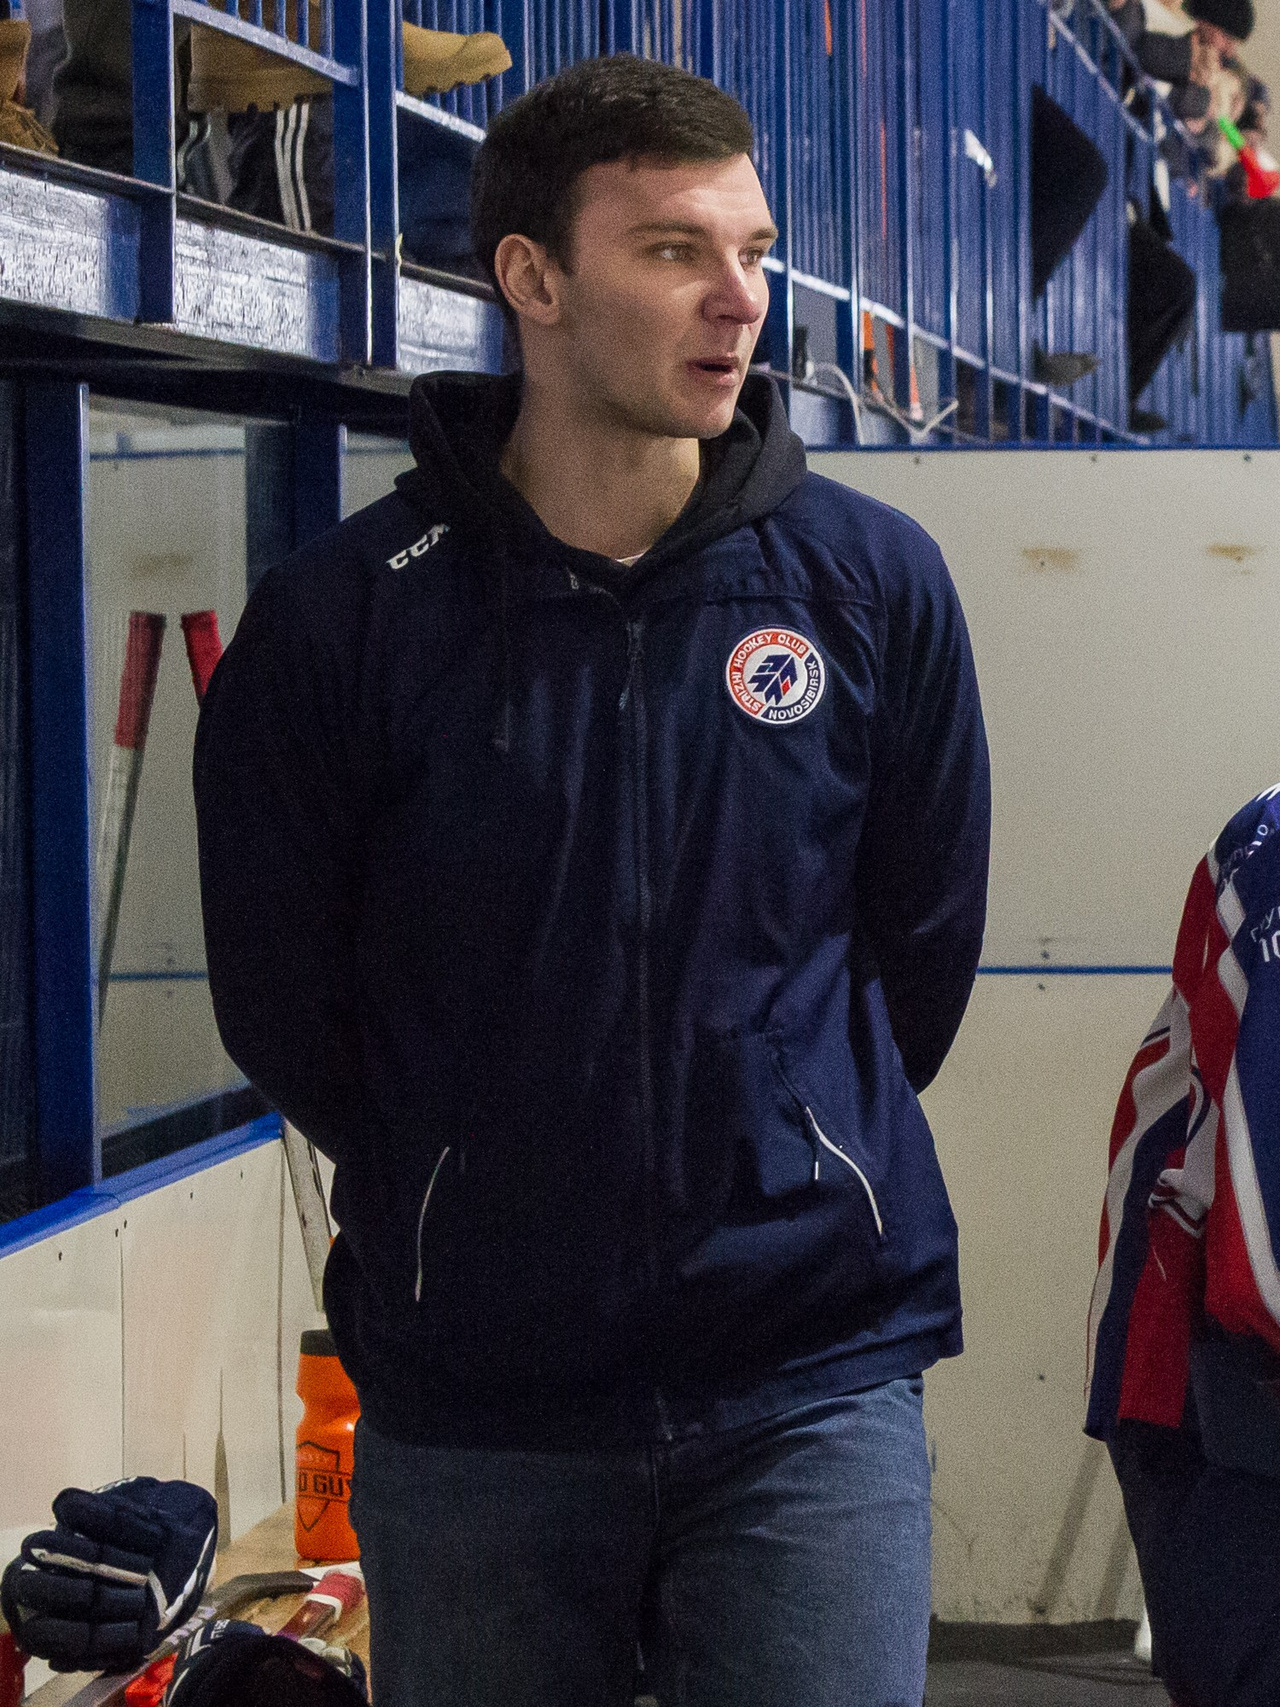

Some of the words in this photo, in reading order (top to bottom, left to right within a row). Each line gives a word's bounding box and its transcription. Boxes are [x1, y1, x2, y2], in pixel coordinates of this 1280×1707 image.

[733, 633, 773, 668] HOCKEY
[777, 633, 807, 655] CLUB
[731, 672, 762, 712] STRIZHI
[768, 660, 819, 721] NOVOSIBIRSK
